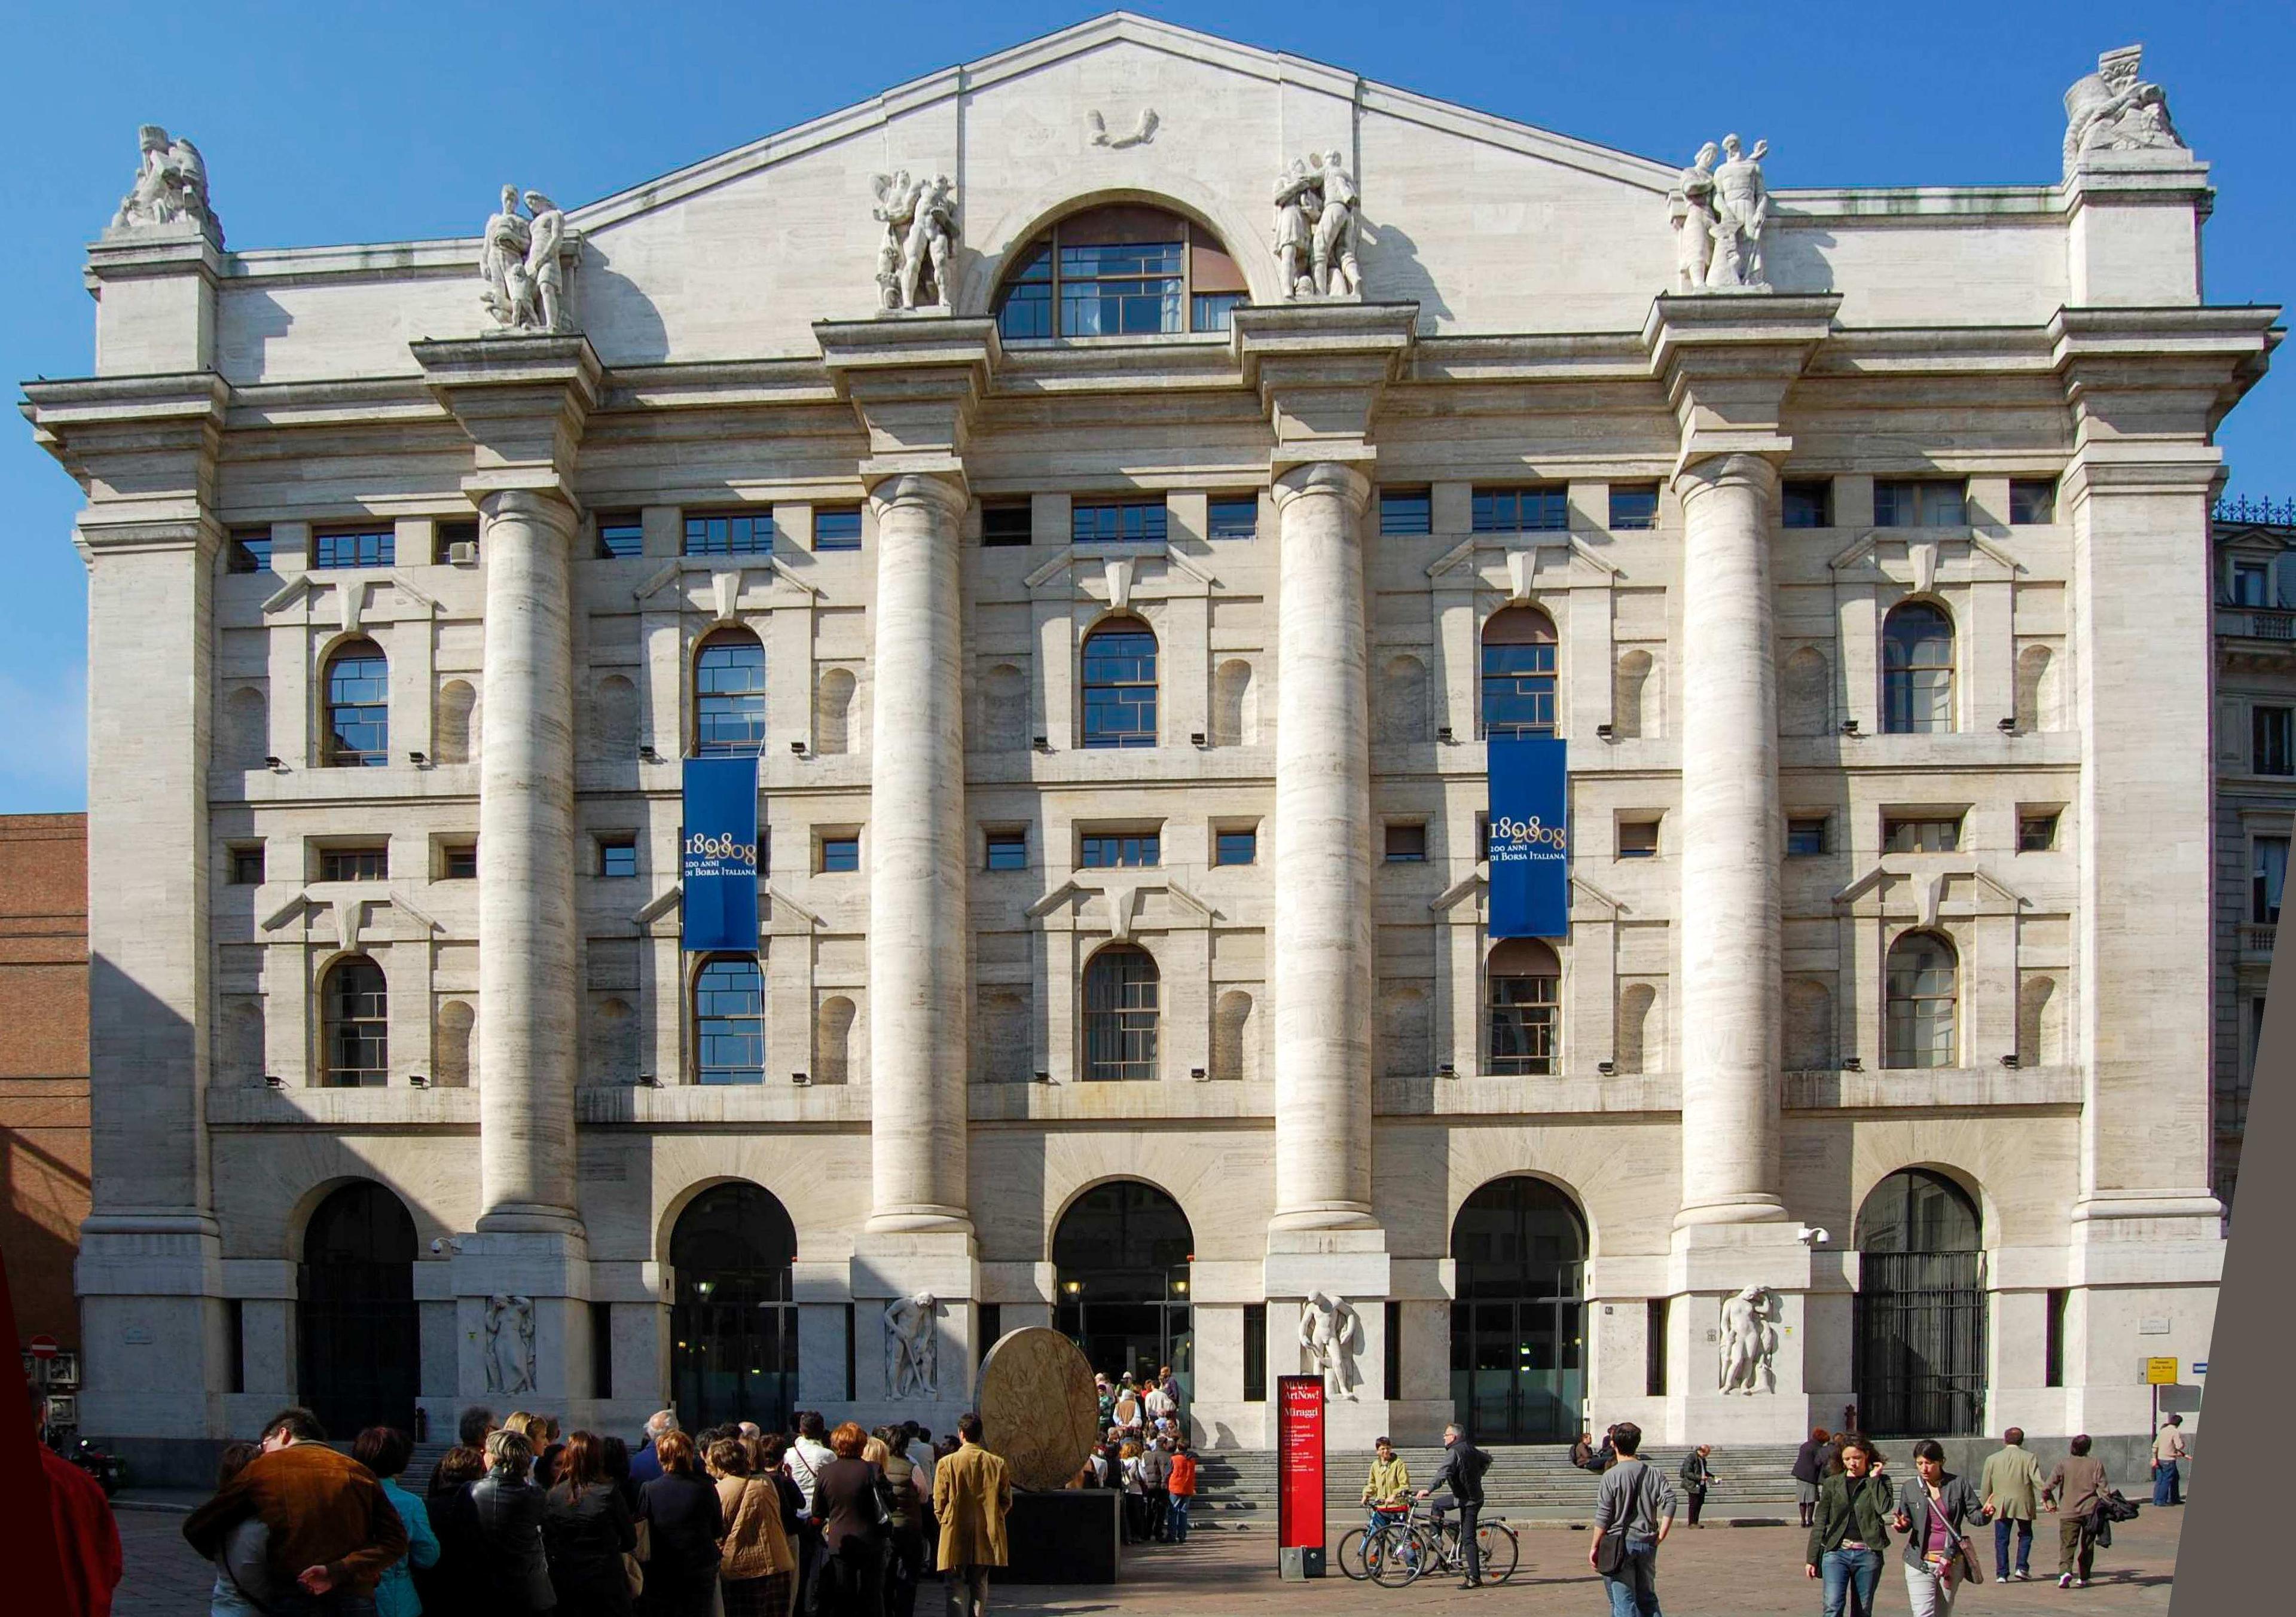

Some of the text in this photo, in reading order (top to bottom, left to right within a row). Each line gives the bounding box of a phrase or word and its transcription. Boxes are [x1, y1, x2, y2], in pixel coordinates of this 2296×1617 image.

[1490, 816, 1540, 838] 1808
[685, 833, 732, 854] 1808
[1512, 829, 1565, 850] 2008
[704, 844, 756, 866] 2008
[1501, 852, 1528, 861] BORSA
[1530, 851, 1565, 860] ITALIANA
[695, 867, 719, 876] BORSA
[721, 867, 756, 876] ITALIANA
[1285, 1407, 1318, 1419] Miraggi
